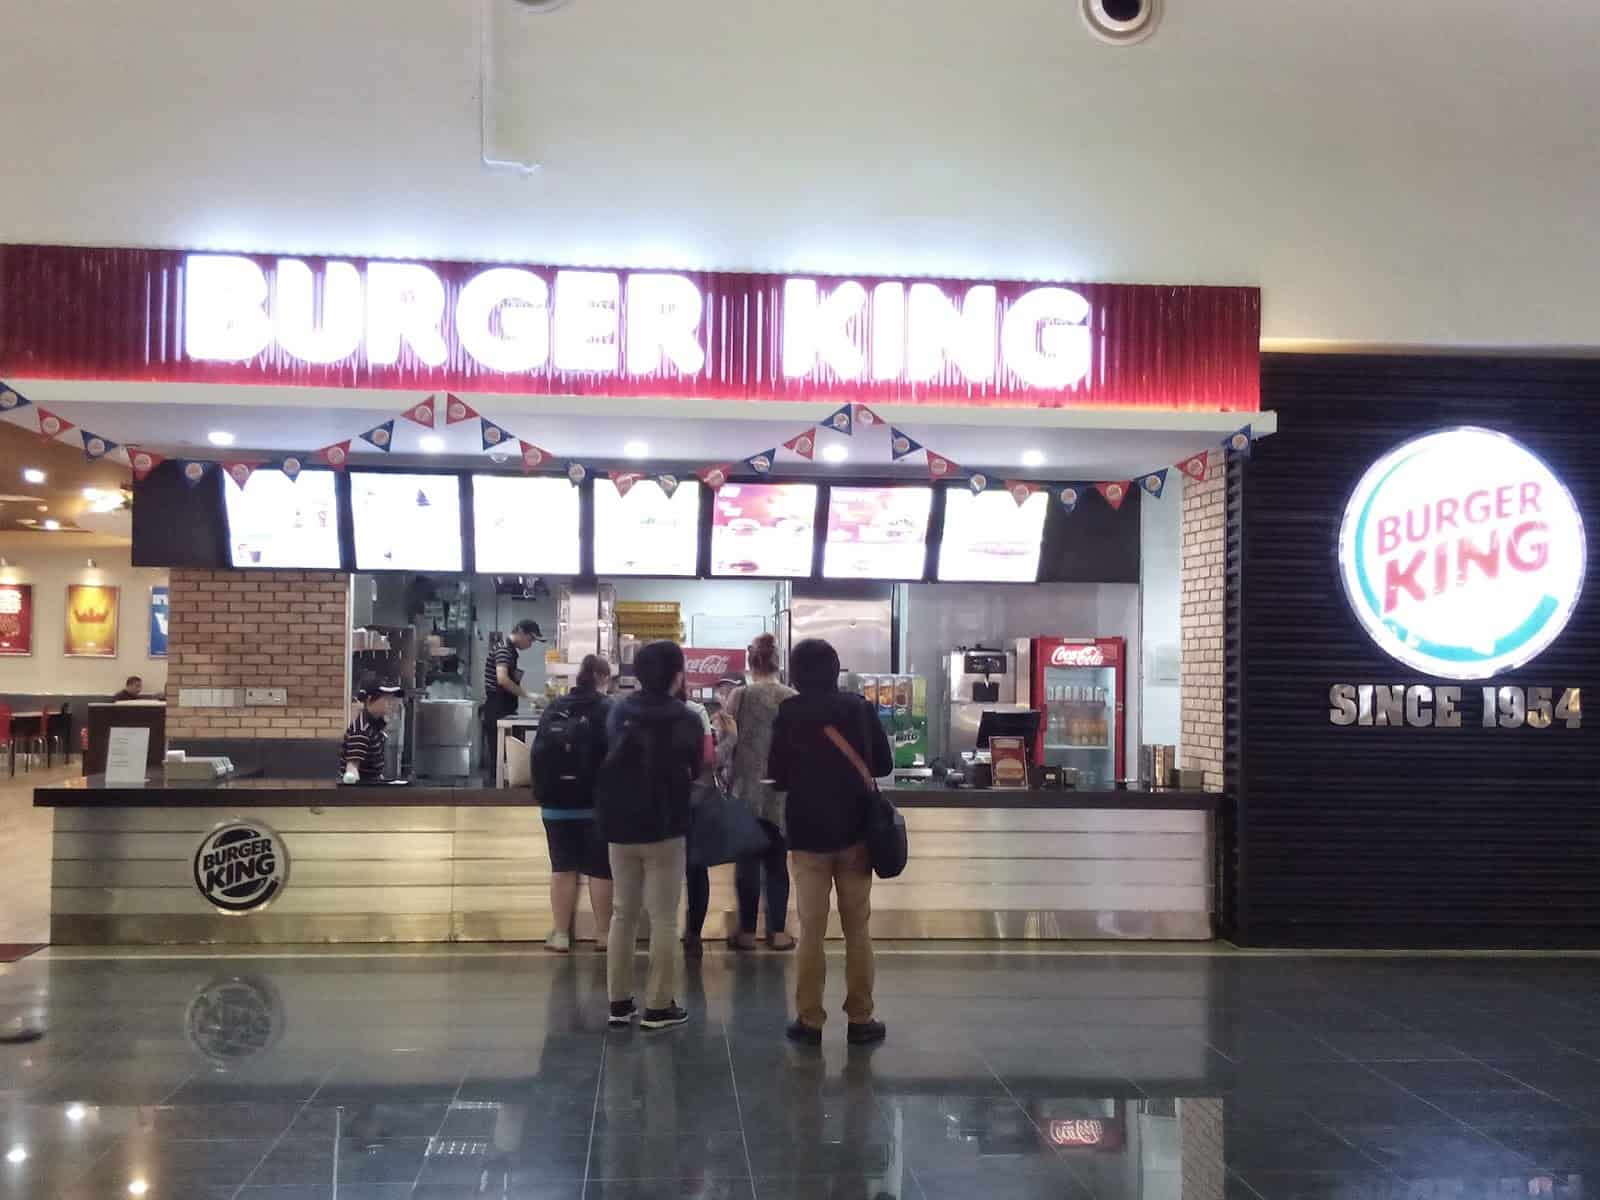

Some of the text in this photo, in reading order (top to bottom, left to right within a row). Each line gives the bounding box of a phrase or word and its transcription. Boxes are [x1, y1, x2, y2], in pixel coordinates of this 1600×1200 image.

[185, 253, 1092, 389] BURGER KING
[1376, 481, 1543, 556] BURGER
[1383, 520, 1549, 614] KING
[1050, 645, 1104, 666] Coca-Cola
[1329, 683, 1583, 729] SINCE 1954
[202, 838, 273, 872] BURGER
[206, 852, 275, 894] KING
